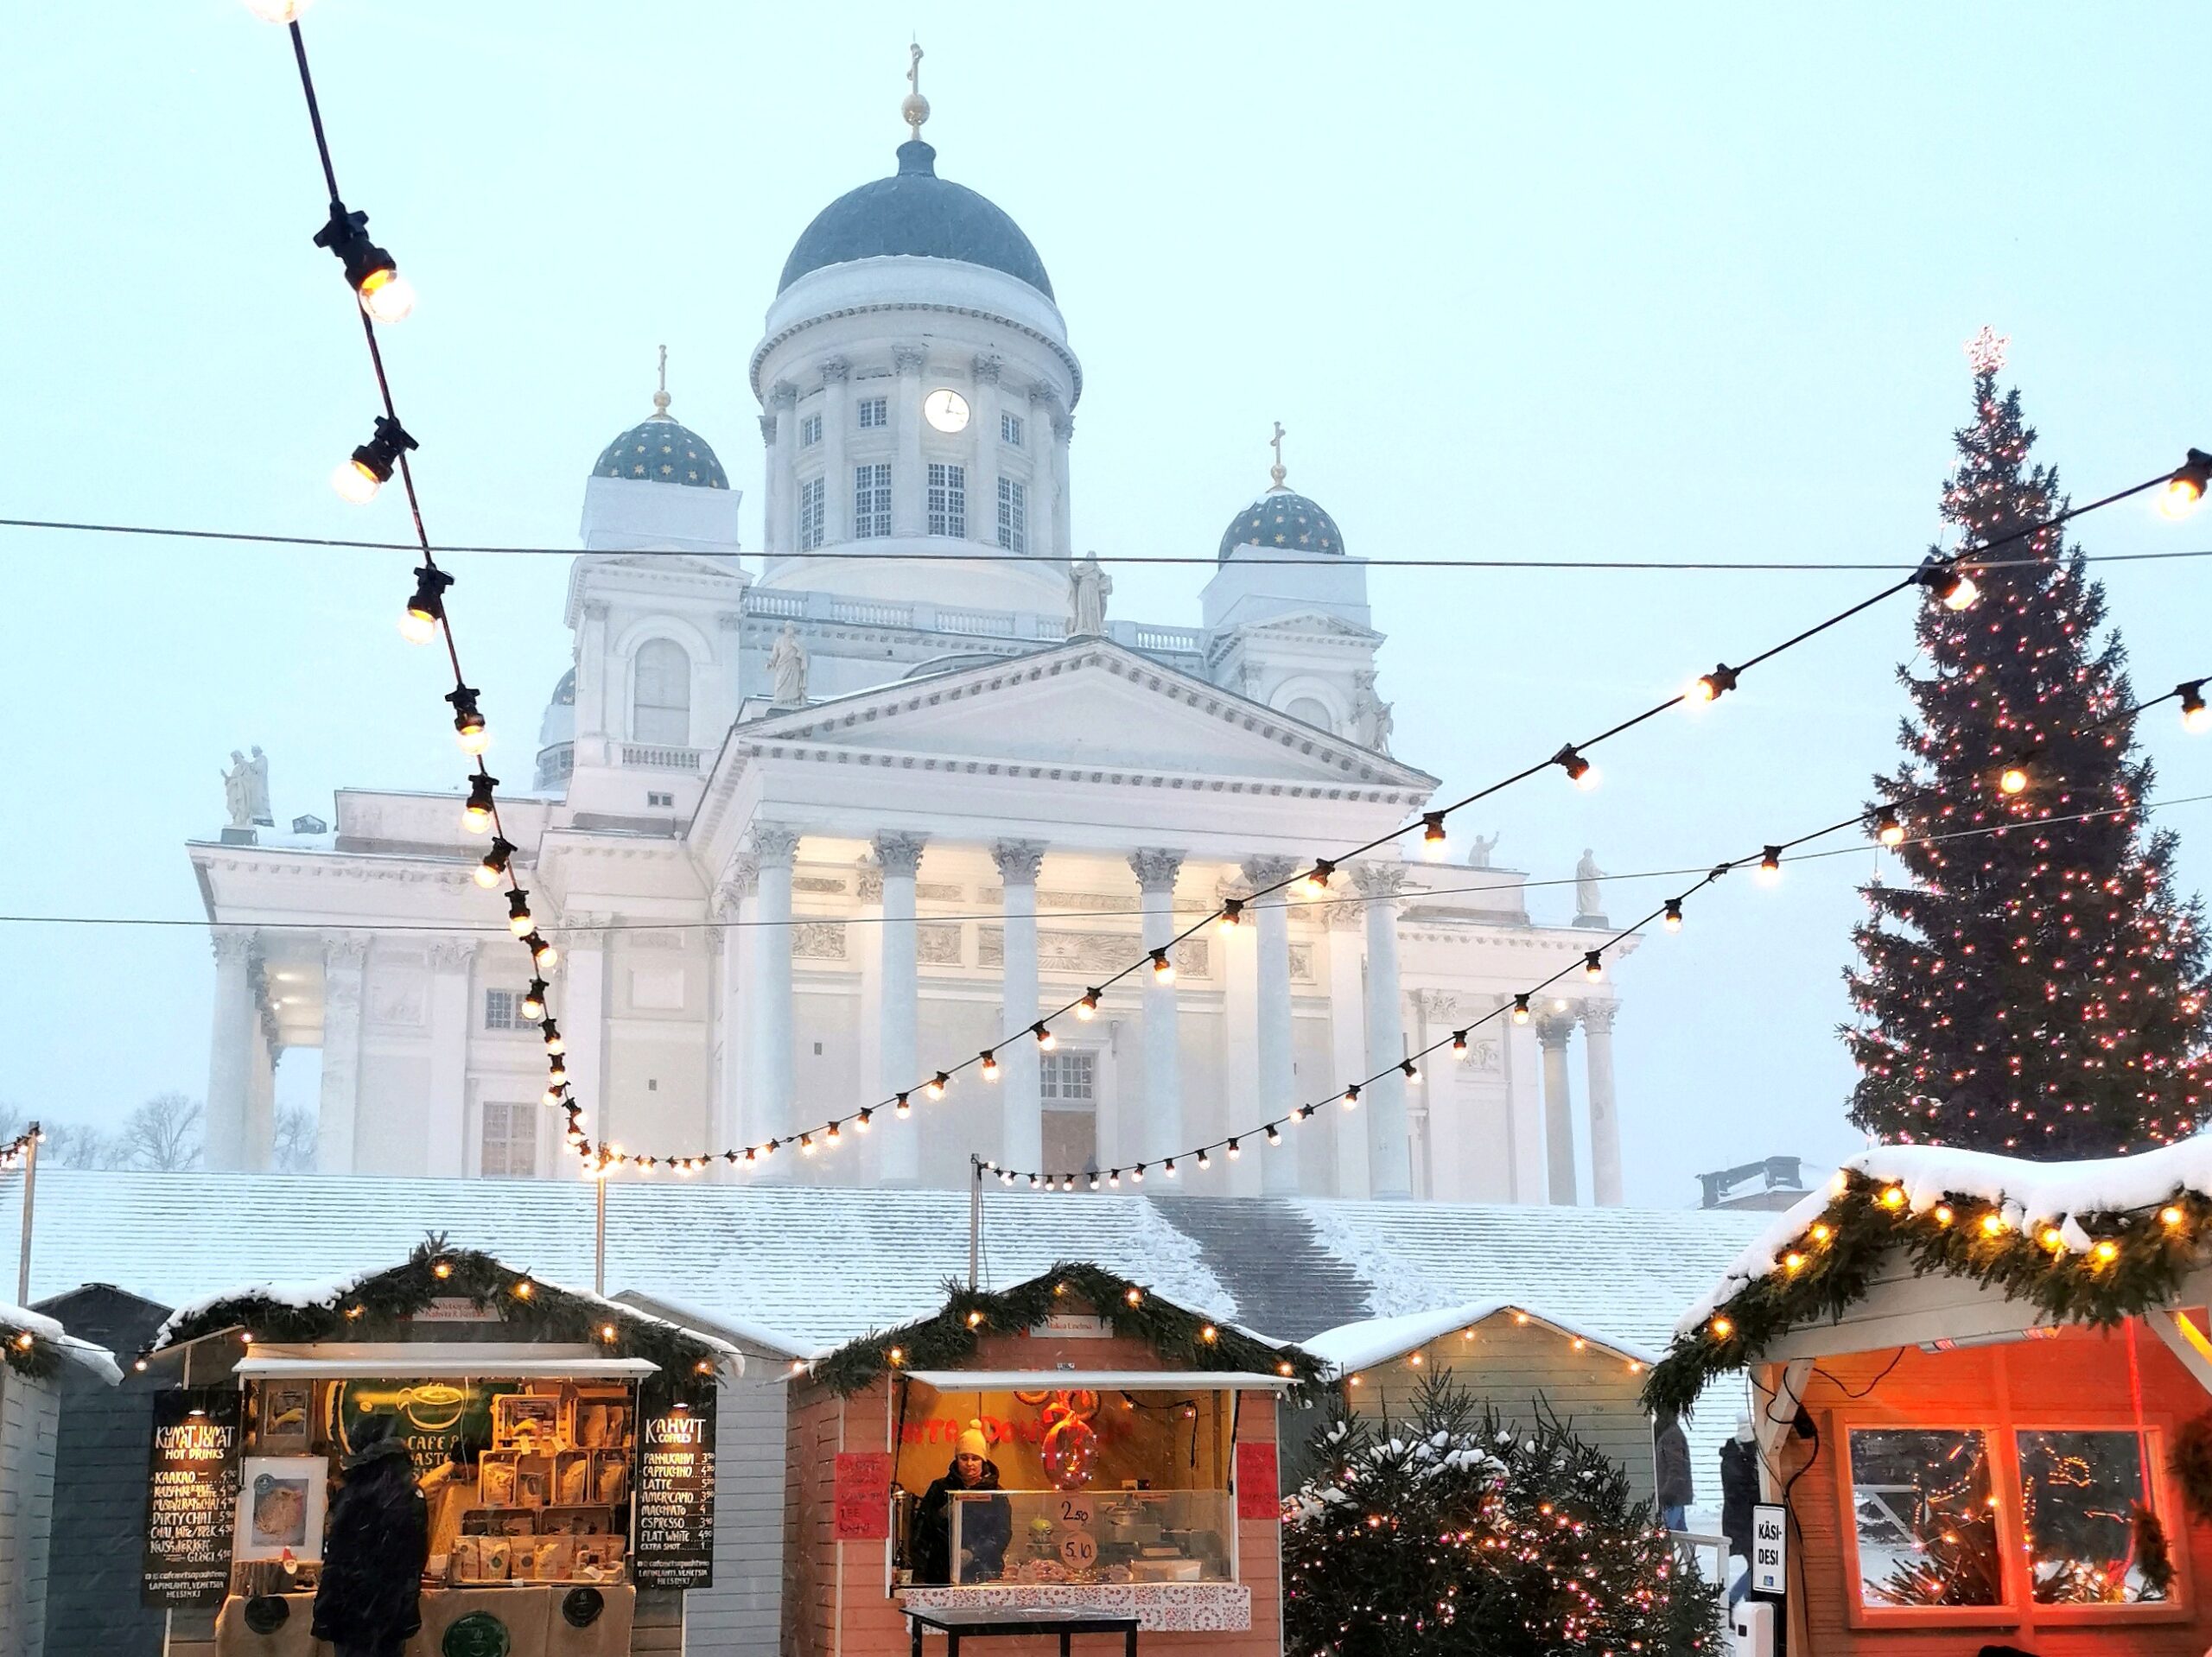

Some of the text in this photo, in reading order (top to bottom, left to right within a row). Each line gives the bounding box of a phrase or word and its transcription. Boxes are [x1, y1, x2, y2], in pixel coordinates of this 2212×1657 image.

[645, 1418, 707, 1444] KAHVIT
[407, 1436, 444, 1451] CAFE
[658, 1433, 692, 1444] COFFEES
[165, 1449, 225, 1460] HOT DRINKS
[155, 1471, 196, 1484] KAAKAO
[642, 1478, 673, 1490] LATTE
[641, 1491, 695, 1504] AMERICANO
[186, 1511, 212, 1524] CHAI
[640, 1517, 685, 1530] ESPRESSO
[641, 1530, 664, 1542] FLAT
[665, 1531, 690, 1542] WHITE
[1758, 1521, 1783, 1541] KÄSI-
[1758, 1548, 1779, 1566] DESI
